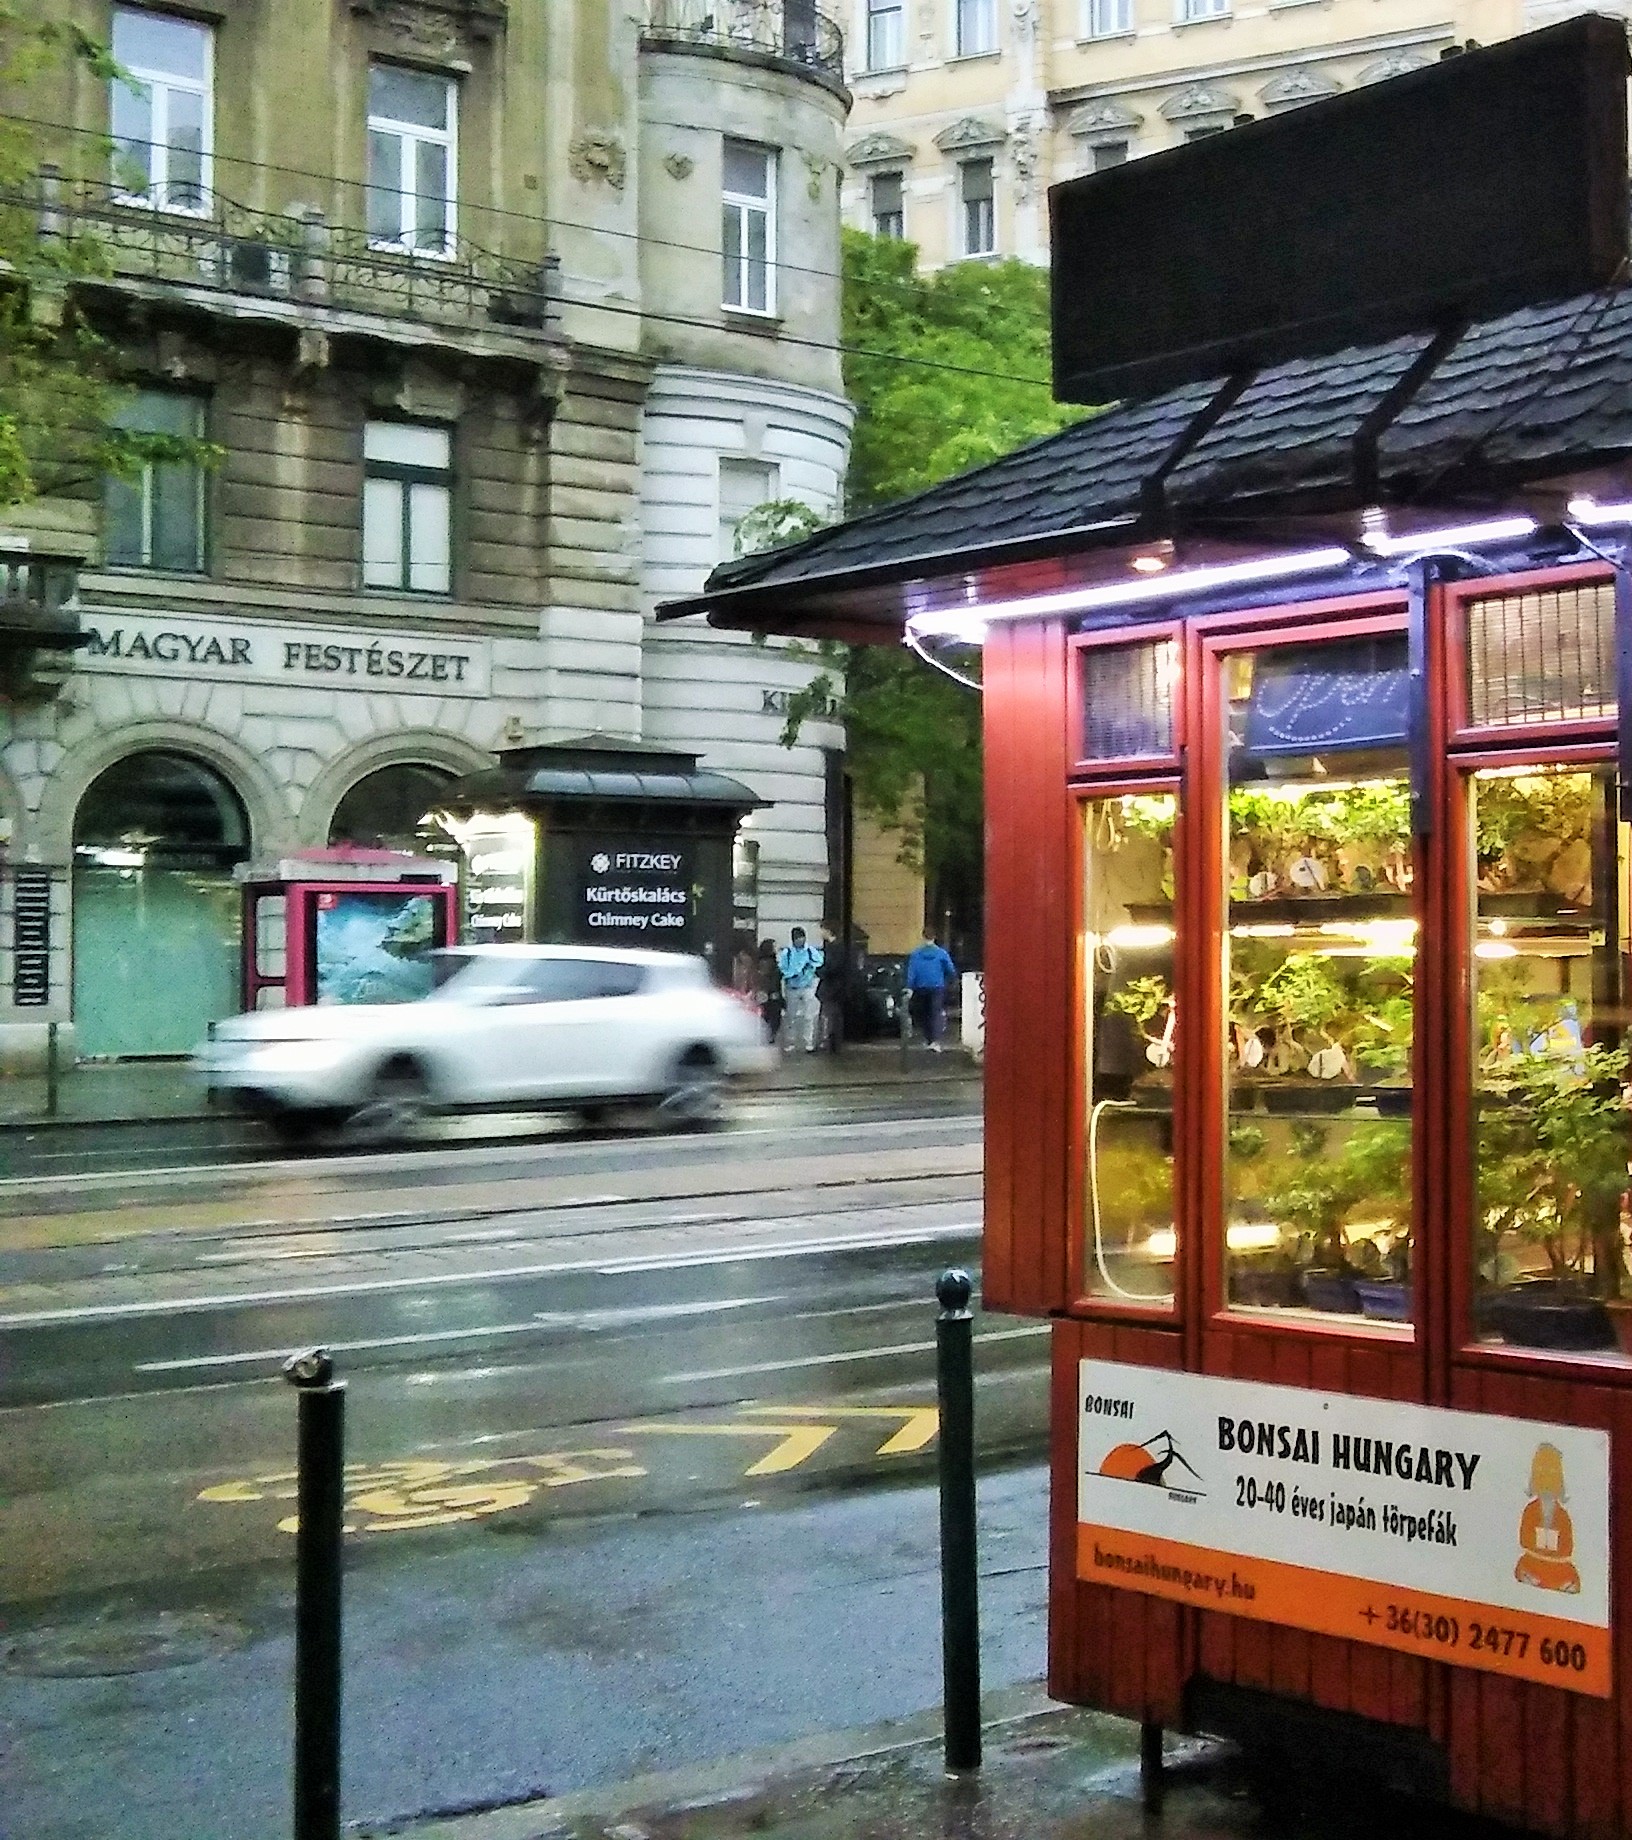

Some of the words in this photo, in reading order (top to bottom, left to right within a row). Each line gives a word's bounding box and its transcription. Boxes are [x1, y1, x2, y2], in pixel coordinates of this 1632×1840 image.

[88, 627, 252, 665] MAGYAR
[283, 641, 470, 682] FESTÉSZET
[616, 853, 682, 869] FITZKEY
[588, 912, 650, 930] Chimney
[650, 912, 685, 927] Cake
[1084, 1394, 1135, 1419] BONSAI
[1217, 1416, 1320, 1464] BONSAI
[1332, 1433, 1481, 1490] HUNGARY
[1236, 1475, 1286, 1513] 20-40
[1291, 1485, 1325, 1522] éves
[1330, 1492, 1376, 1531] japán
[1382, 1504, 1458, 1546] törpefák
[1094, 1542, 1256, 1600] bonsaihungary.hu
[1468, 1623, 1531, 1659] 2477
[1540, 1637, 1587, 1671] 600
